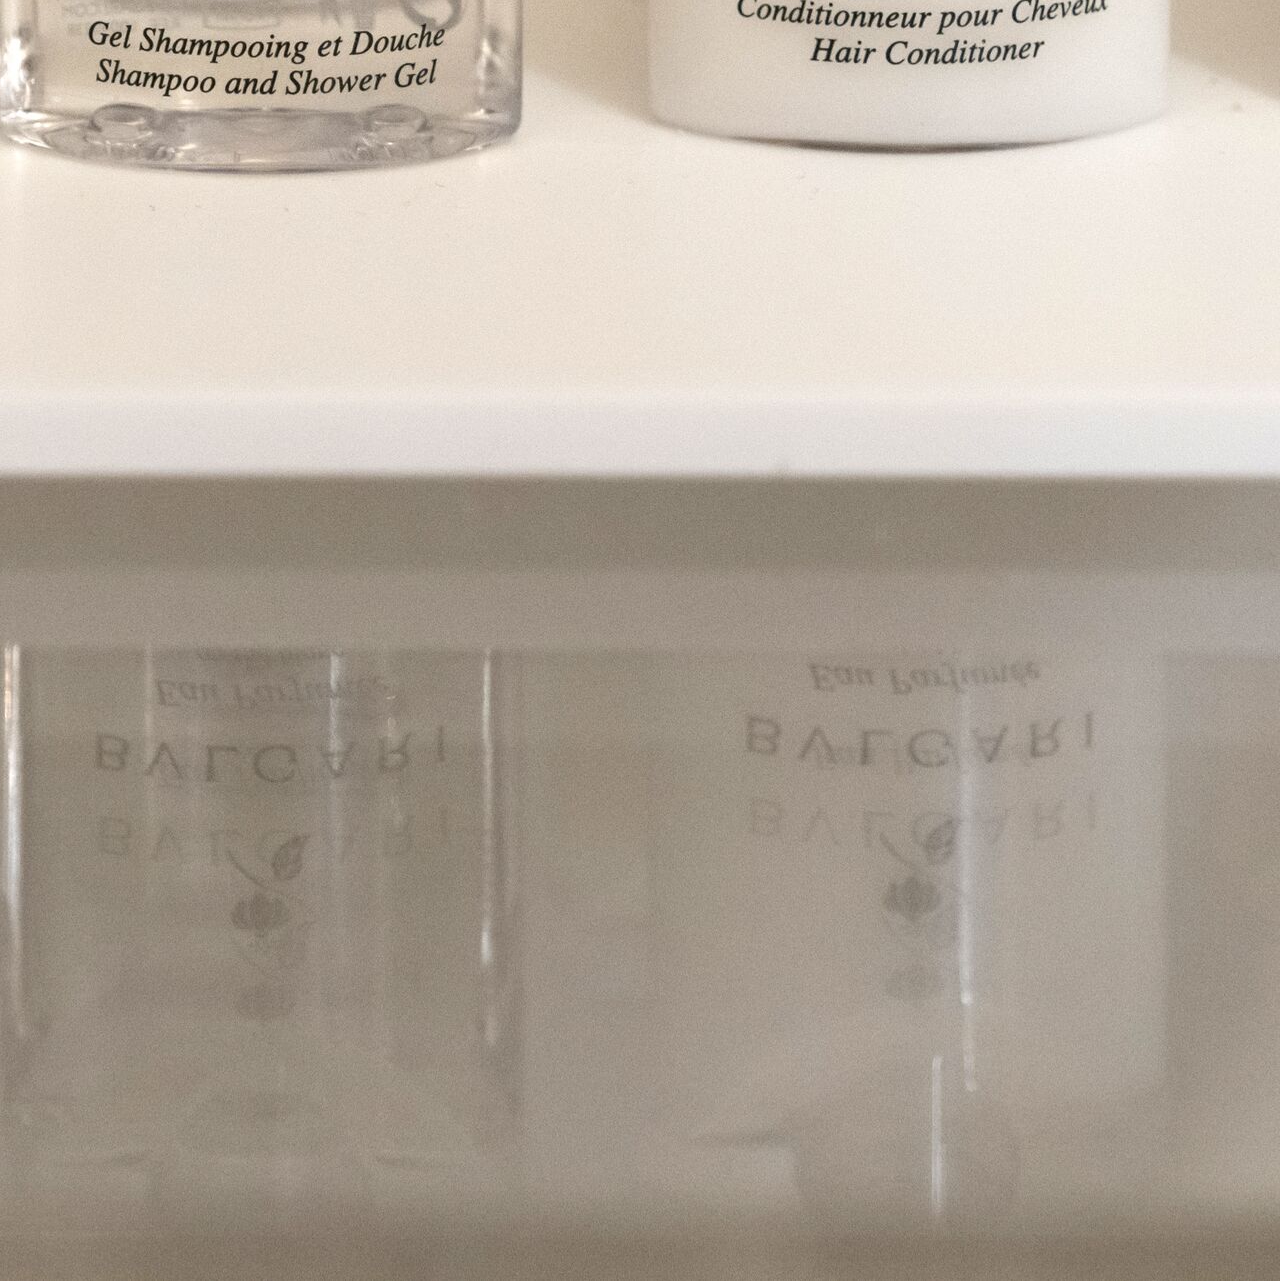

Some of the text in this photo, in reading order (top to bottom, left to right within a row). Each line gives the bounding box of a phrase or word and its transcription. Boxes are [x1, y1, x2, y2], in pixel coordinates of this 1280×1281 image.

[936, 8, 1004, 36] pour
[88, 21, 446, 65] Gel Shampooing et Douche
[811, 37, 1045, 66] Hair Conditioner
[96, 57, 437, 97] Shampoo and Shower Gel
